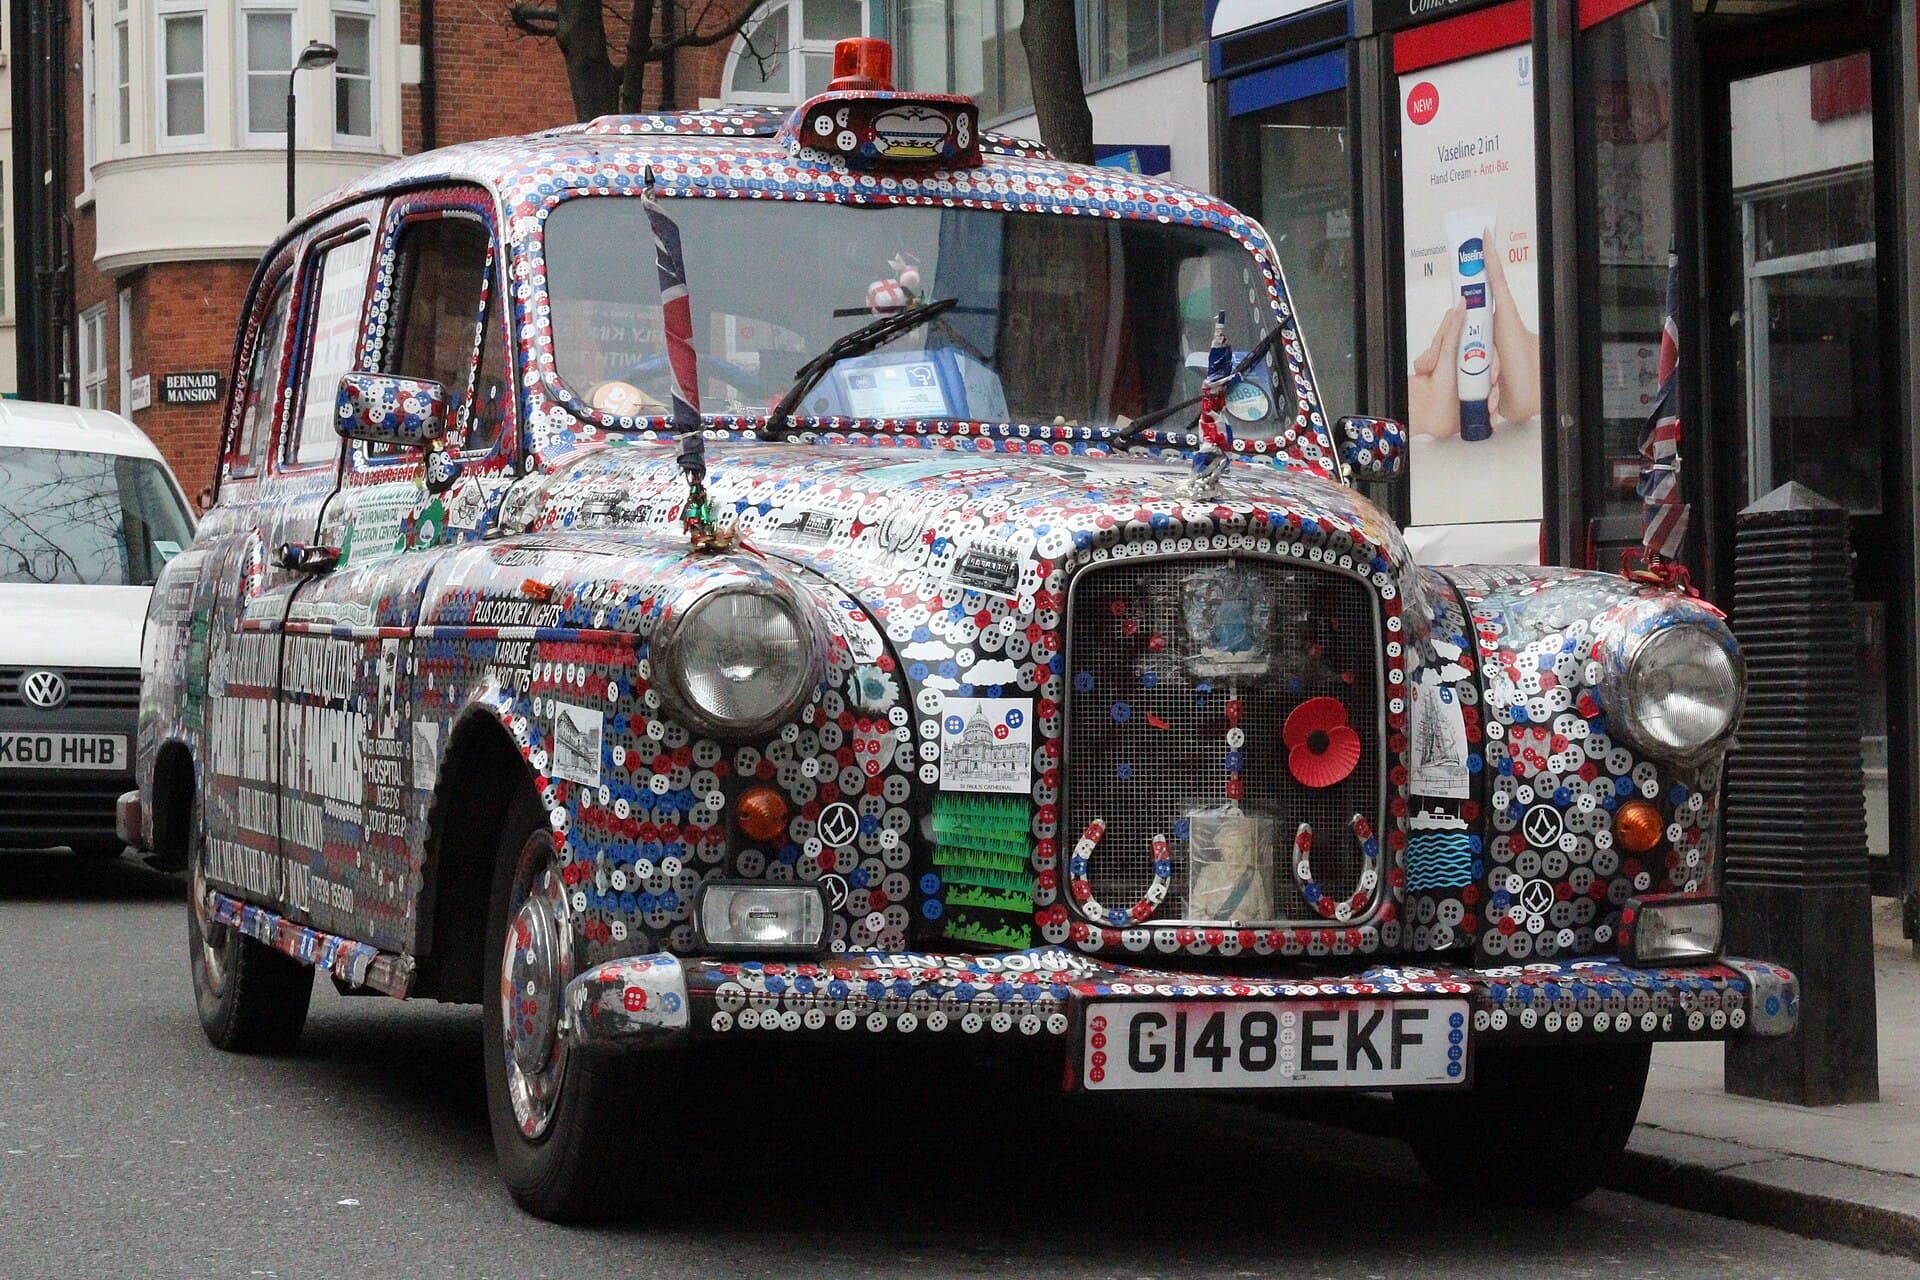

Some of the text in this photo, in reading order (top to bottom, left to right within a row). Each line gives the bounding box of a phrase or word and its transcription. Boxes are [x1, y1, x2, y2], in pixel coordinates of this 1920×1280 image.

[1413, 97, 1433, 114] NEW!
[1438, 140, 1476, 163] Vaseline
[1430, 171, 1449, 186] Hand
[1449, 168, 1472, 182] Cream
[1480, 160, 1509, 176] Anti-Bac
[1459, 250, 1484, 263] Vaseline
[1508, 246, 1529, 263] OUT
[1424, 263, 1433, 277] IN
[166, 375, 217, 388] BERNARD
[167, 388, 218, 402] MANSION
[472, 601, 564, 628] PLUS COCKNEY NIGHTS
[494, 641, 531, 665] KARAOKE
[61, 737, 115, 764] HHB
[211, 696, 363, 806] PEARLY KING OF ST PANCRAS
[368, 759, 404, 786] HOSPITAL
[376, 785, 400, 810] NEEDS
[369, 809, 407, 838] YOUR HELP
[244, 846, 262, 895] THE
[871, 953, 967, 969] LEN'S
[1127, 1008, 1430, 1074] G148 EKF
